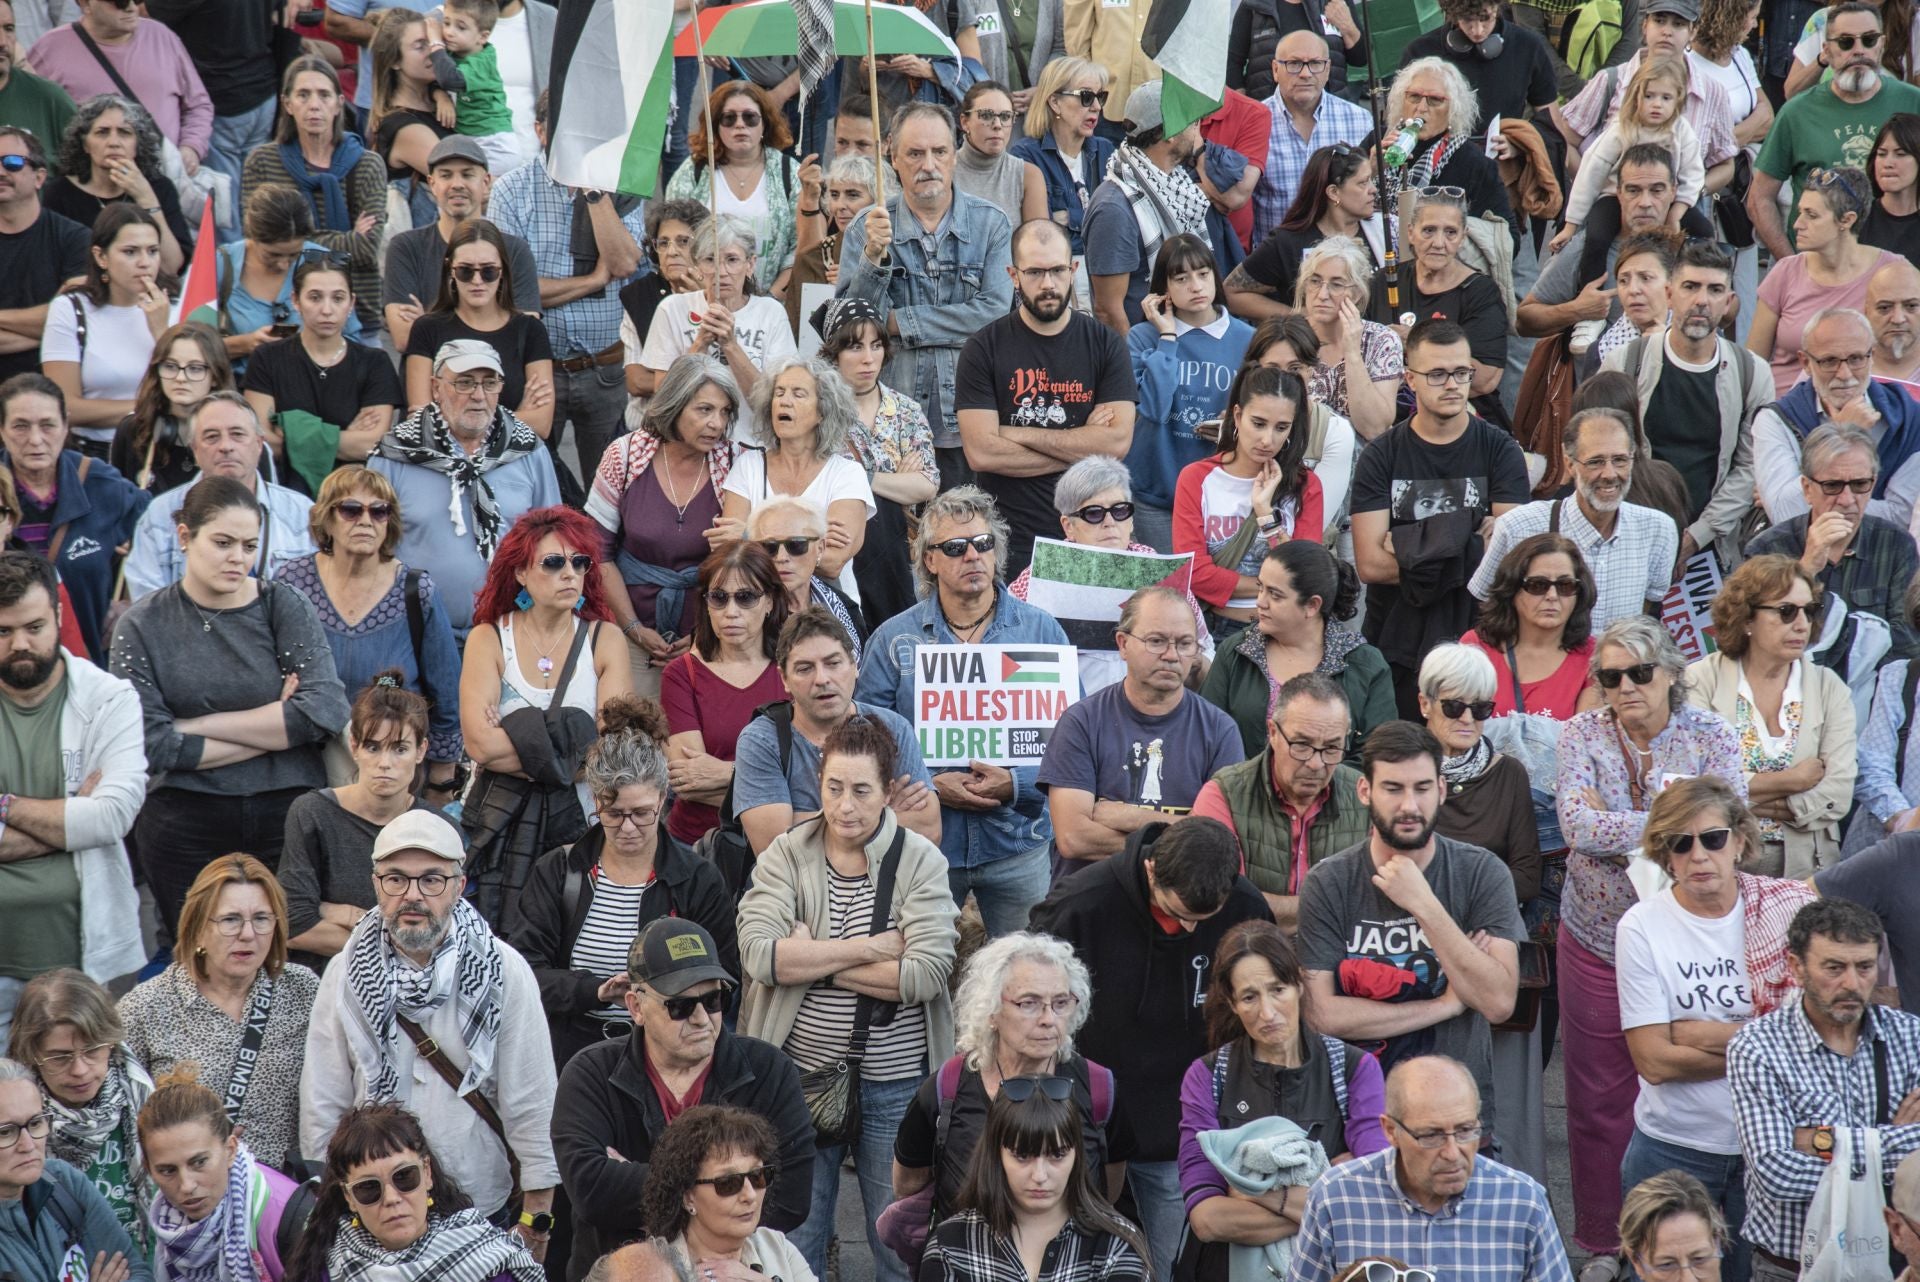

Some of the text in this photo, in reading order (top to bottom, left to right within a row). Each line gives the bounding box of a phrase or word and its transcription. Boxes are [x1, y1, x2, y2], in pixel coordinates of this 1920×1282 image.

[1685, 557, 1718, 617] VIVA
[921, 652, 987, 684] VIVA
[921, 689, 1069, 722] PALESTINA
[919, 727, 1004, 759] LIBRE
[1012, 730, 1039, 743] STOP
[1345, 924, 1434, 956] JACK
